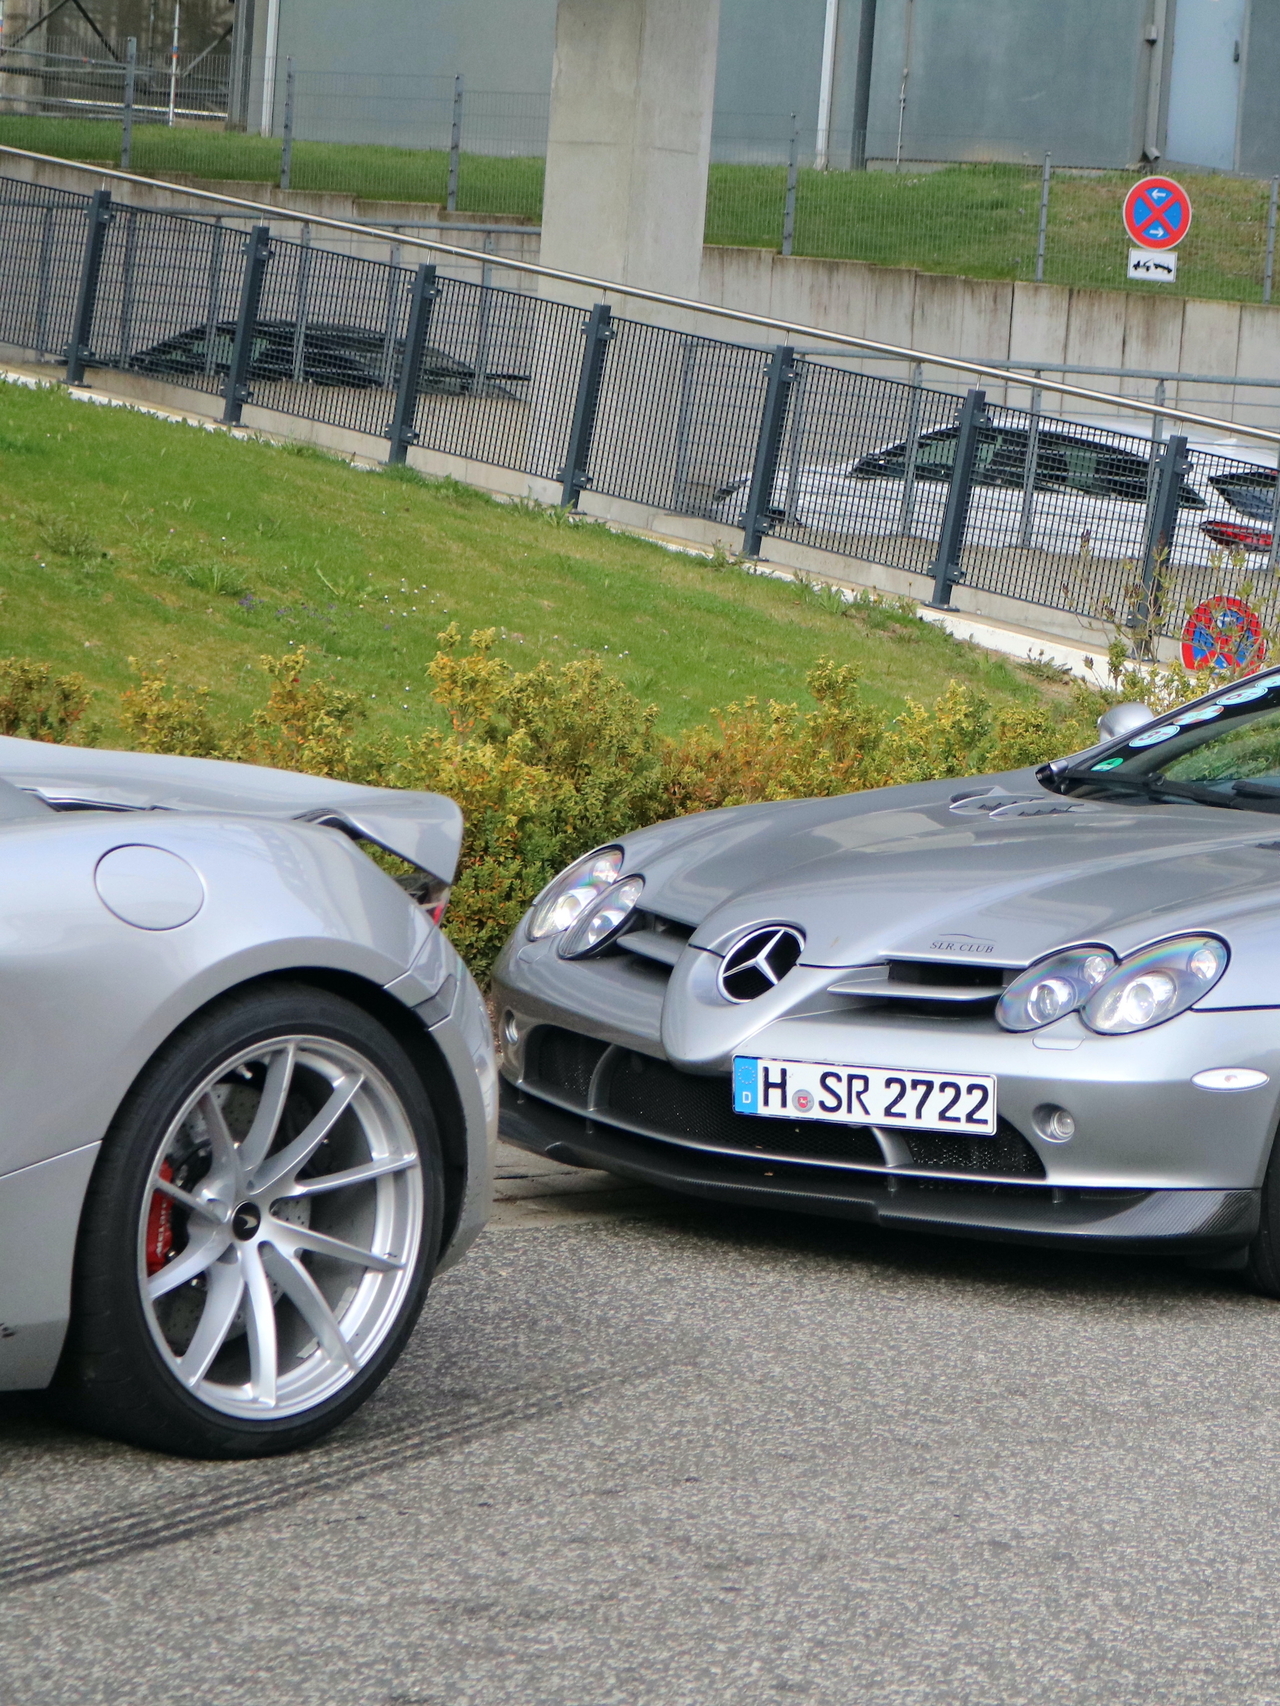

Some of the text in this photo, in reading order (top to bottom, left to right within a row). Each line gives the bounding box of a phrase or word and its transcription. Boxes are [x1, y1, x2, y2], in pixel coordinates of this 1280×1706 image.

[959, 944, 995, 953] CLUB
[742, 1091, 752, 1104] D
[763, 1066, 989, 1126] H SR 2722
